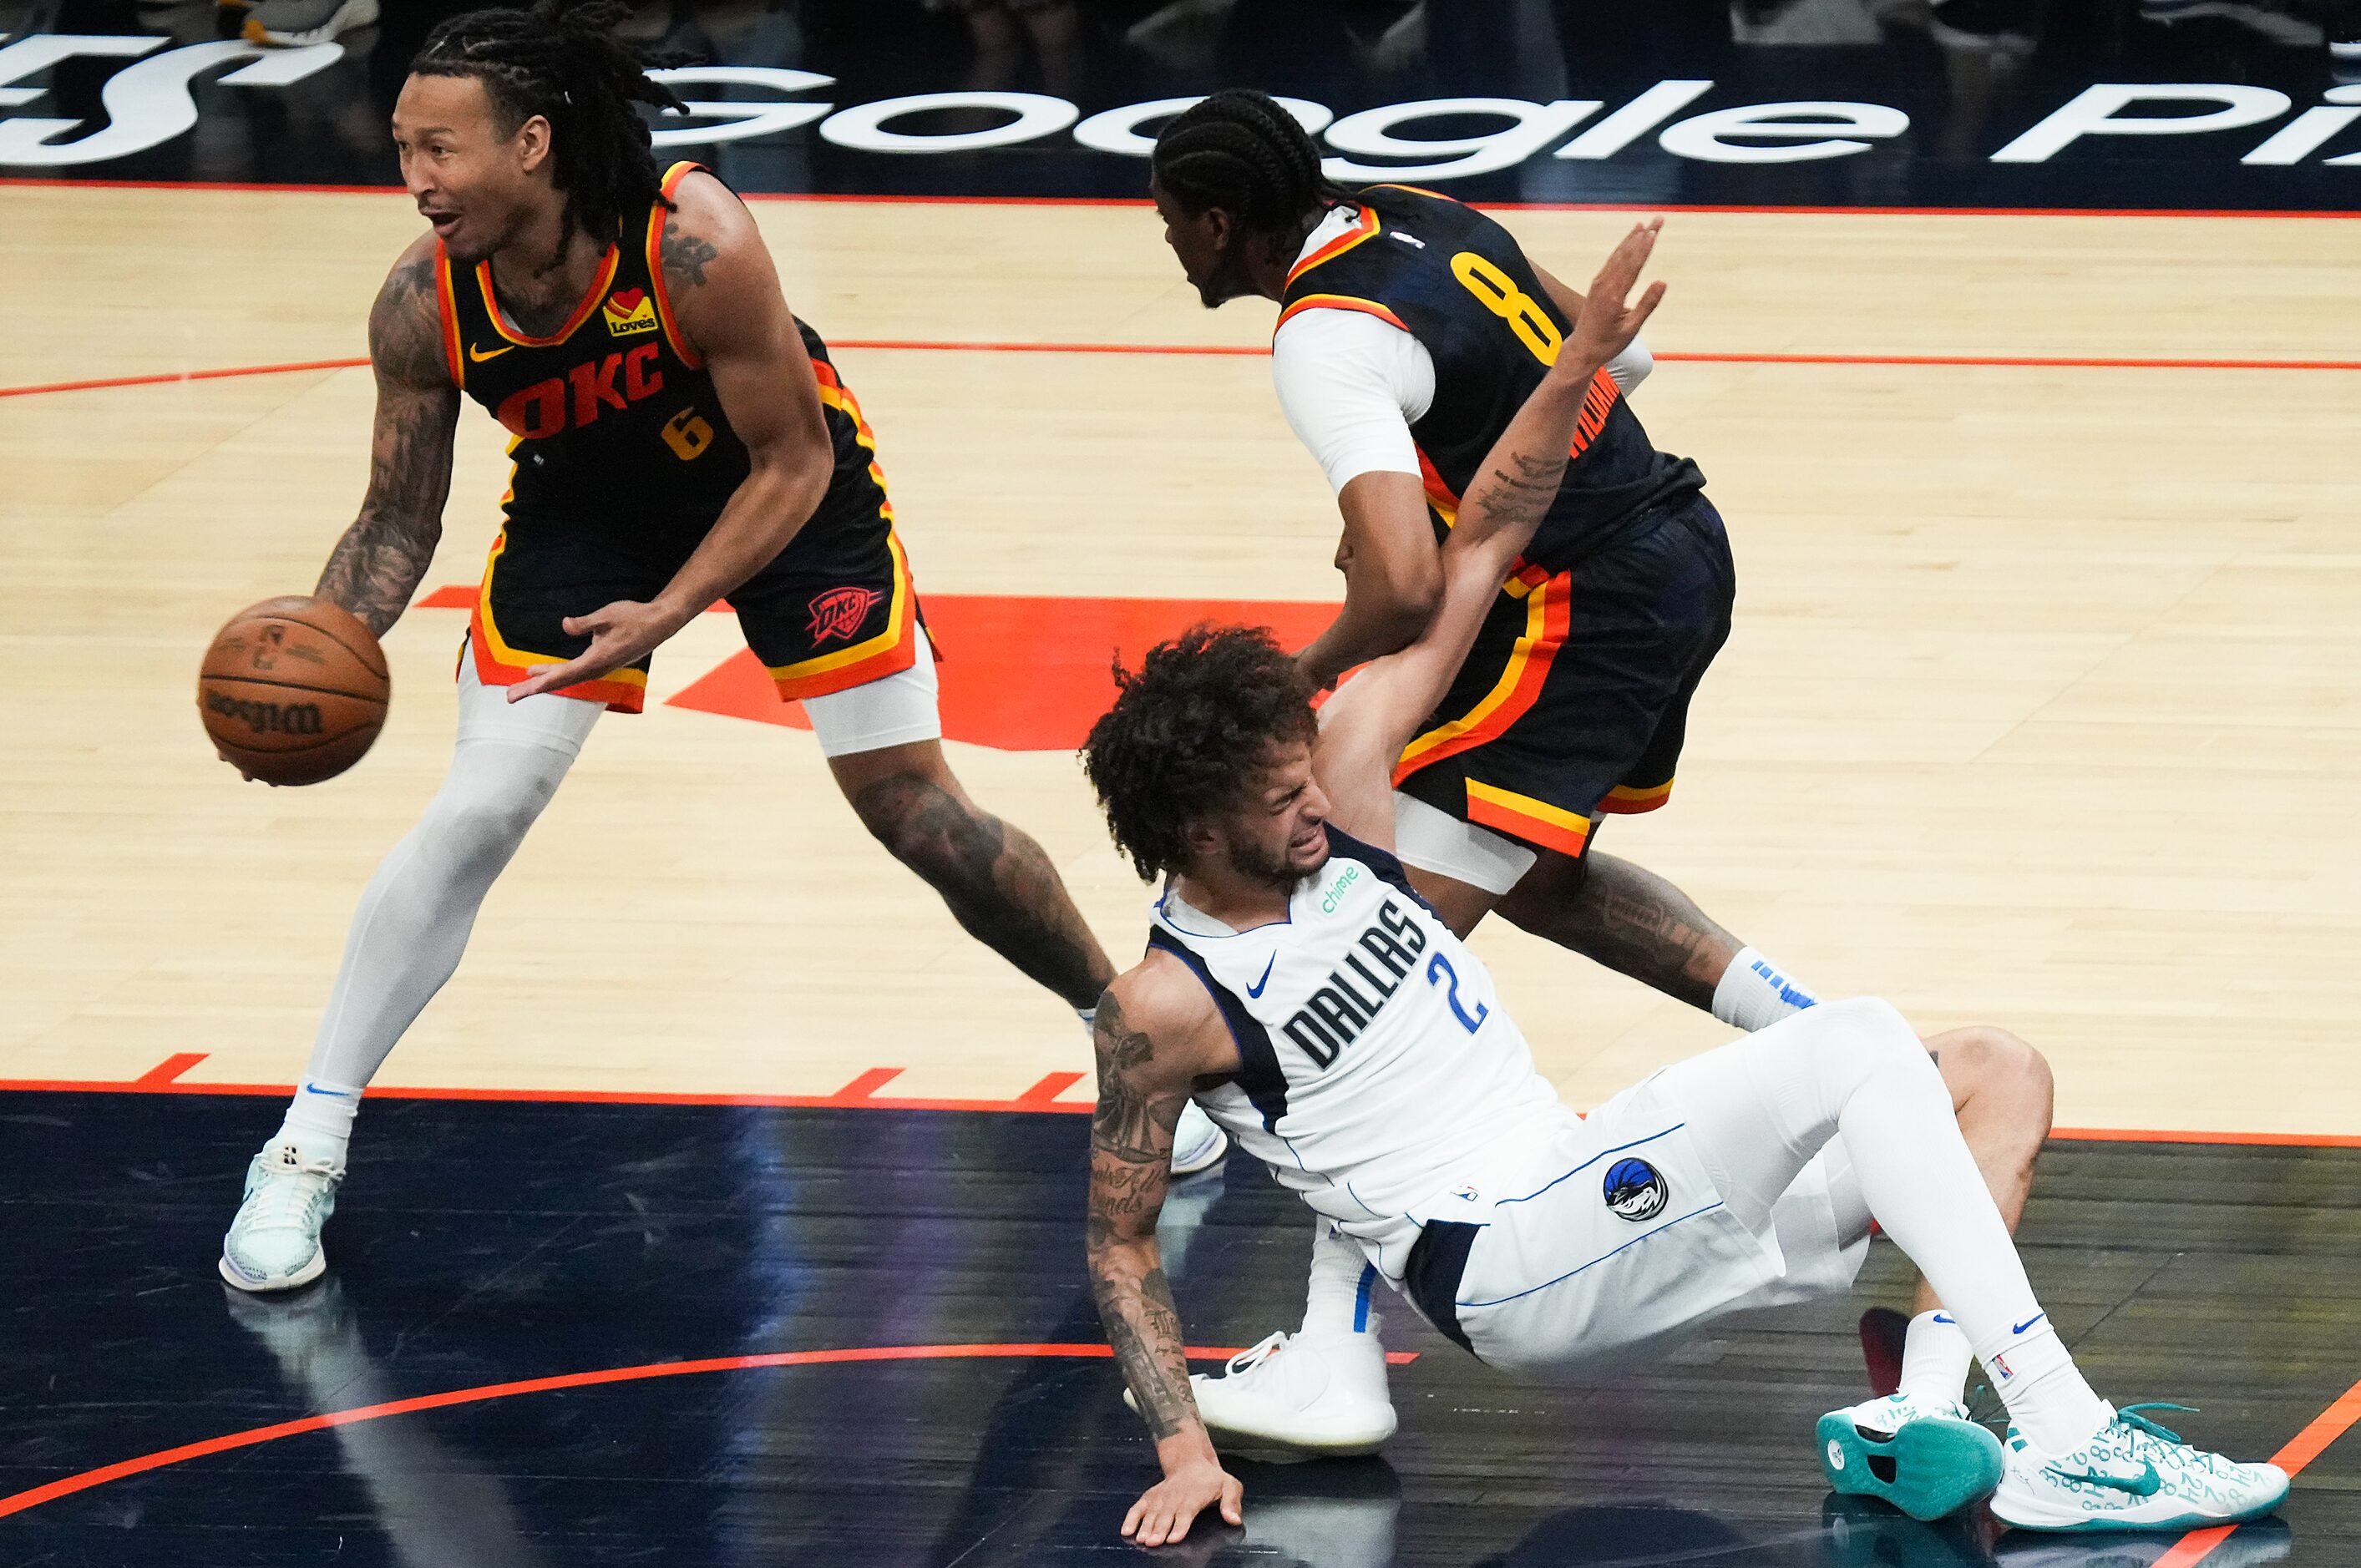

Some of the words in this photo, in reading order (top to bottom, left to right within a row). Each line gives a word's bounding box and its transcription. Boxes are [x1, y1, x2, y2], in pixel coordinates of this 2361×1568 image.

[642, 65, 1911, 182] Google
[1989, 83, 2361, 166] Pi
[1449, 251, 1563, 367] 8
[496, 341, 664, 440] OKC
[660, 406, 715, 462] 6
[1321, 864, 1360, 915] chime
[1281, 898, 1427, 1072] DALLAS
[1425, 949, 1489, 1036] 2
